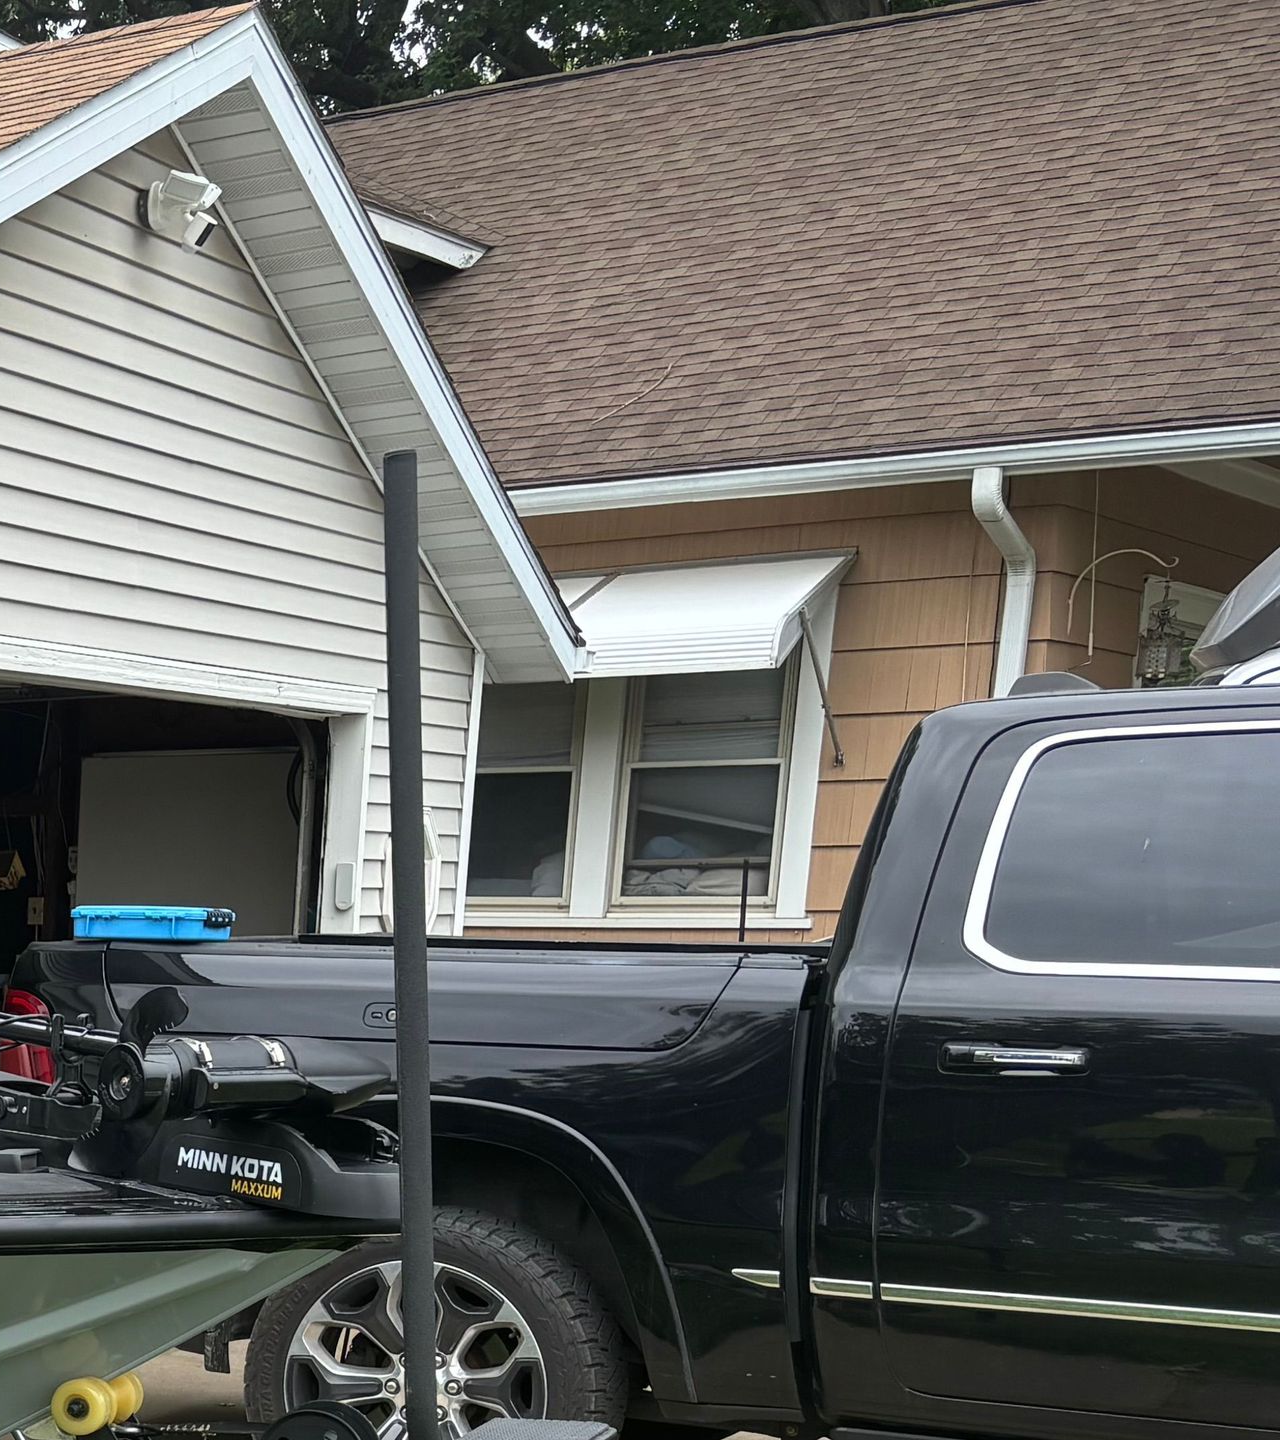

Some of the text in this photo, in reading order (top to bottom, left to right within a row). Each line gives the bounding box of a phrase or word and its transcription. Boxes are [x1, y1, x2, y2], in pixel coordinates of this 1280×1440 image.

[177, 1146, 283, 1184] MINN KOTA
[230, 1179, 282, 1200] MAXXUM
